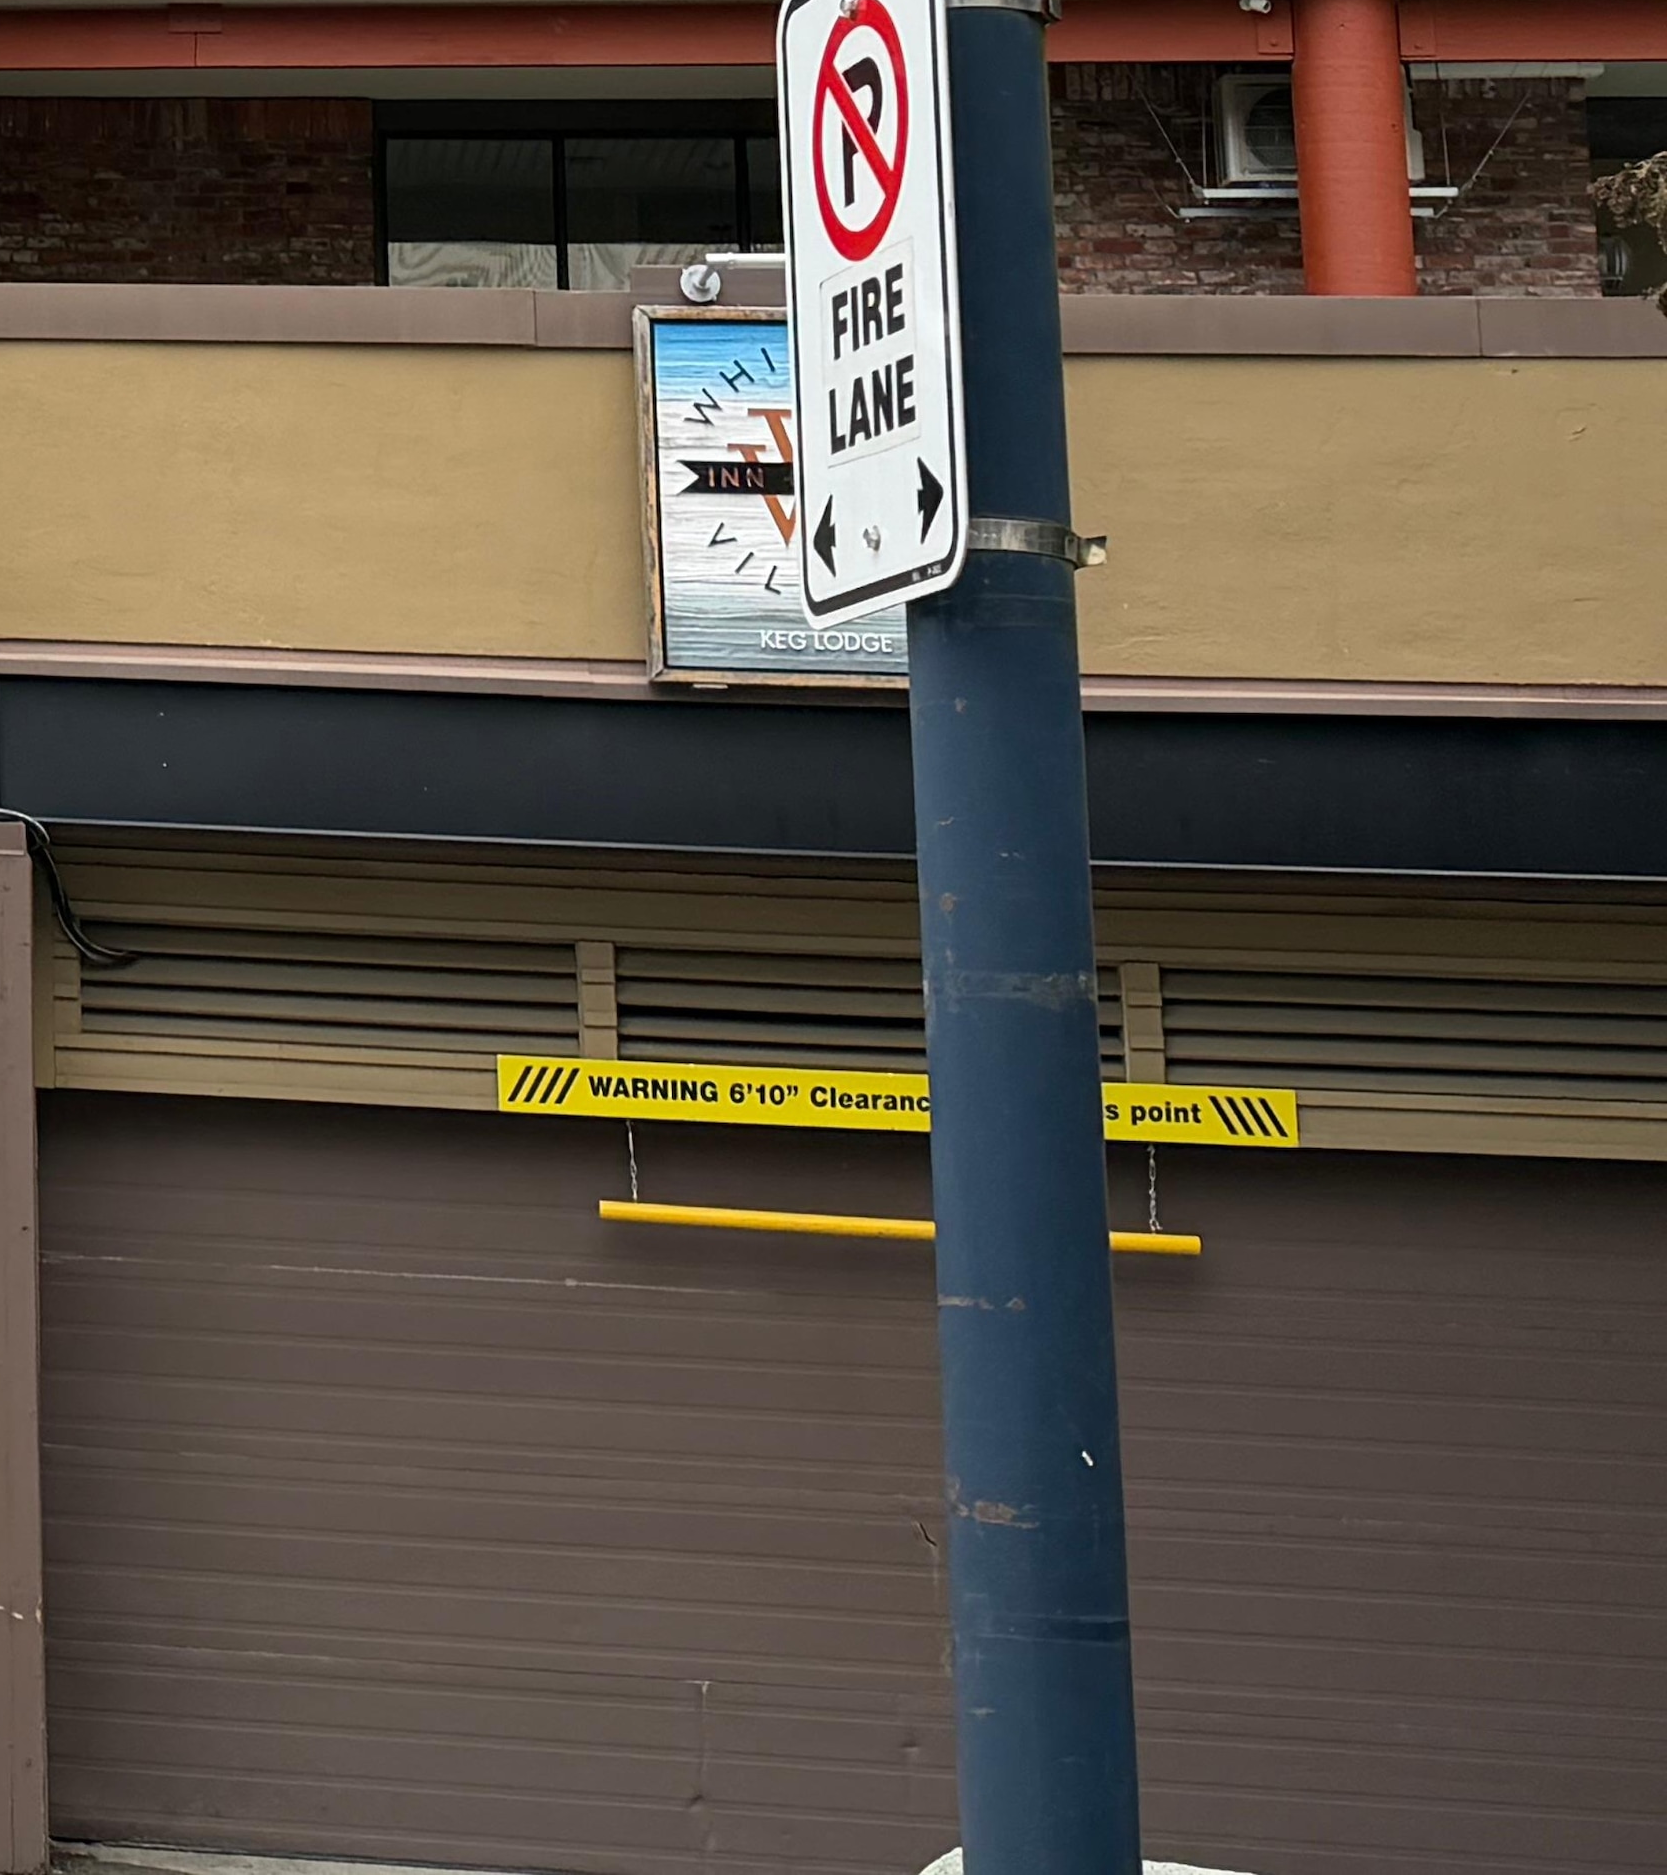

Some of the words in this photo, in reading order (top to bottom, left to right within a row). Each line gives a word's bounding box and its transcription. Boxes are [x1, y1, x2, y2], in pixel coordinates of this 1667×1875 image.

[831, 263, 906, 361] FIRE
[828, 353, 917, 456] LANE
[707, 466, 765, 488] INN
[760, 629, 808, 651] KEG
[813, 630, 894, 653] LODGE
[587, 1074, 719, 1104] WARNING
[810, 1085, 931, 1113] Clearanc
[1130, 1100, 1202, 1126] point
